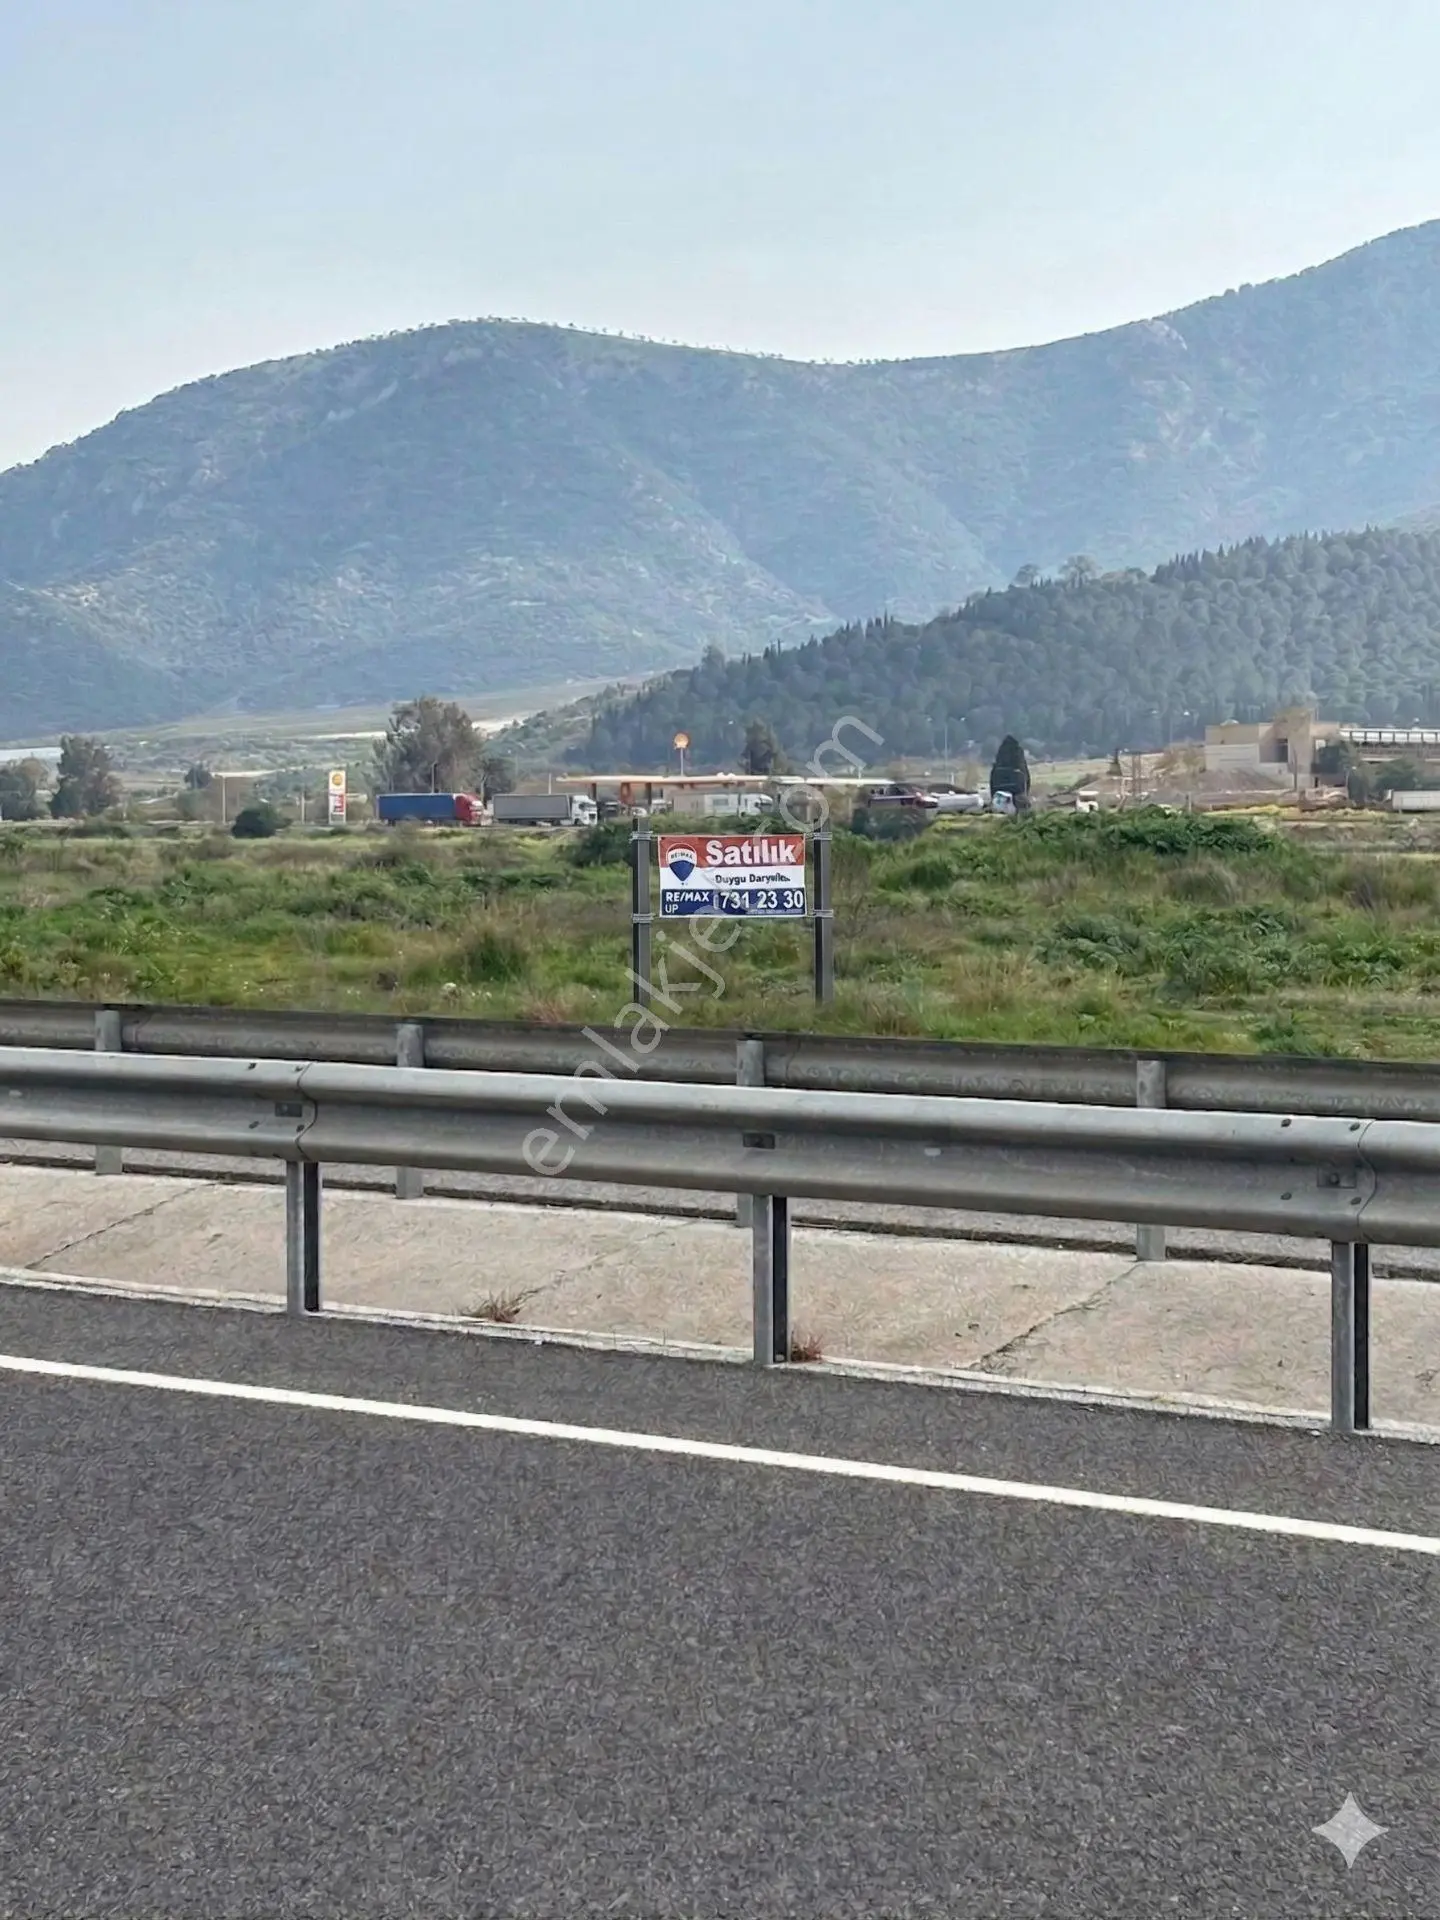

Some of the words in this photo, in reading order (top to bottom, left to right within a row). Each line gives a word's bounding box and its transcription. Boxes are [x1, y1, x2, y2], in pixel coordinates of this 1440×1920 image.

[706, 839, 797, 866] Satılık
[715, 874, 747, 885] Duygu
[665, 891, 710, 902] RE/MAX
[720, 891, 750, 909] 731
[757, 890, 778, 909] 23
[783, 890, 804, 909] 30
[664, 904, 679, 913] UP
